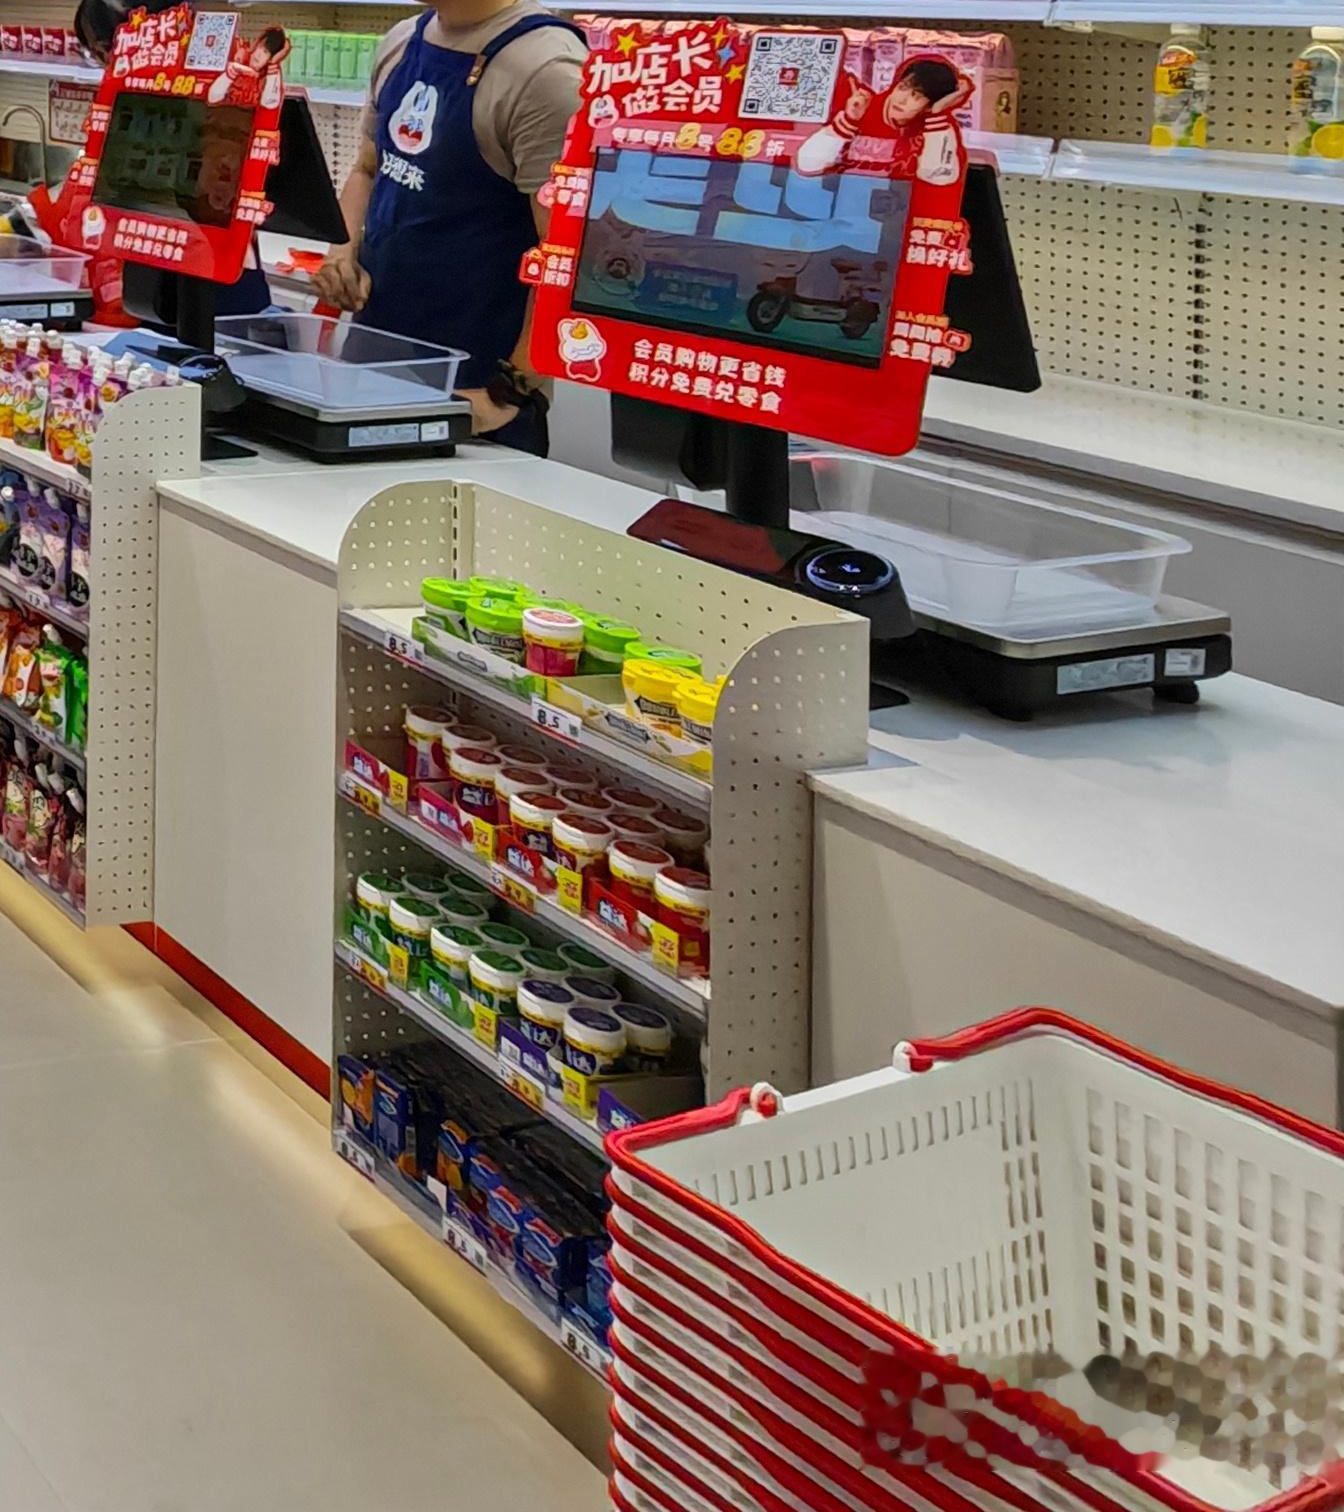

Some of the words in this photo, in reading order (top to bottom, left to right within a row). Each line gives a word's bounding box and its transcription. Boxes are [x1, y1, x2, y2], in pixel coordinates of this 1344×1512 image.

[587, 31, 713, 94] 加店长
[622, 75, 723, 118] 做会员
[628, 361, 782, 415] 积分免费兑零食
[634, 338, 787, 388] 会员购物更省钱
[537, 708, 561, 730] 8.5
